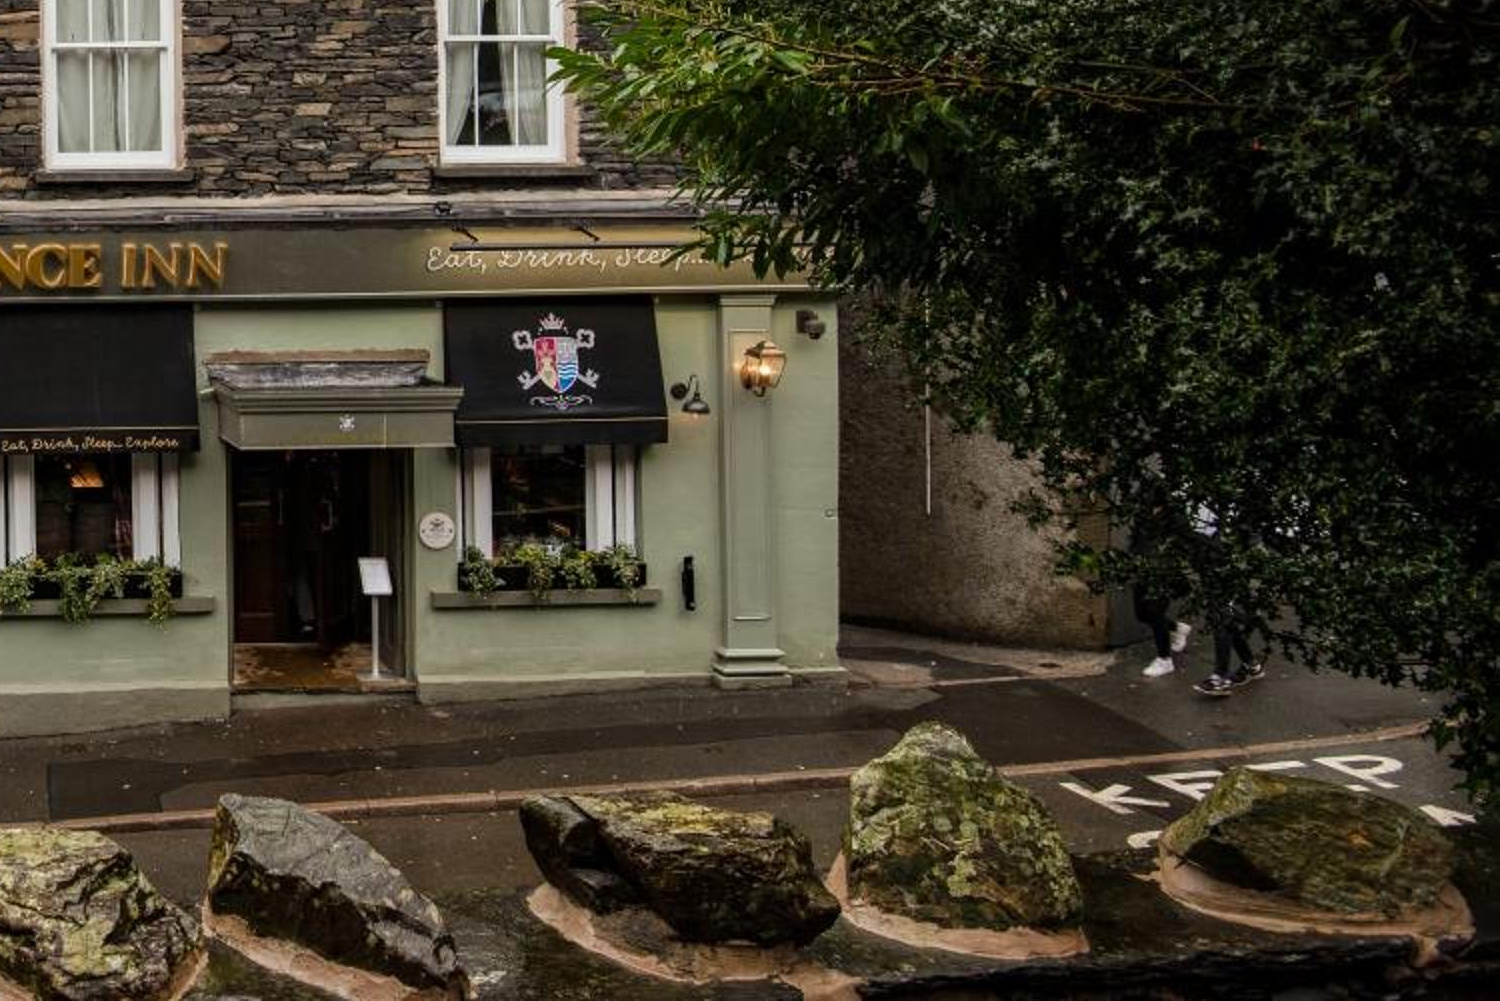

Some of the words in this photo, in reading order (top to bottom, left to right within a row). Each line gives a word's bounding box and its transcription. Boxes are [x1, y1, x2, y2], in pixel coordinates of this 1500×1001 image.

[118, 241, 229, 289] INN
[427, 246, 487, 274] Eat,
[497, 249, 606, 273] Drink,
[124, 435, 179, 450] Explore
